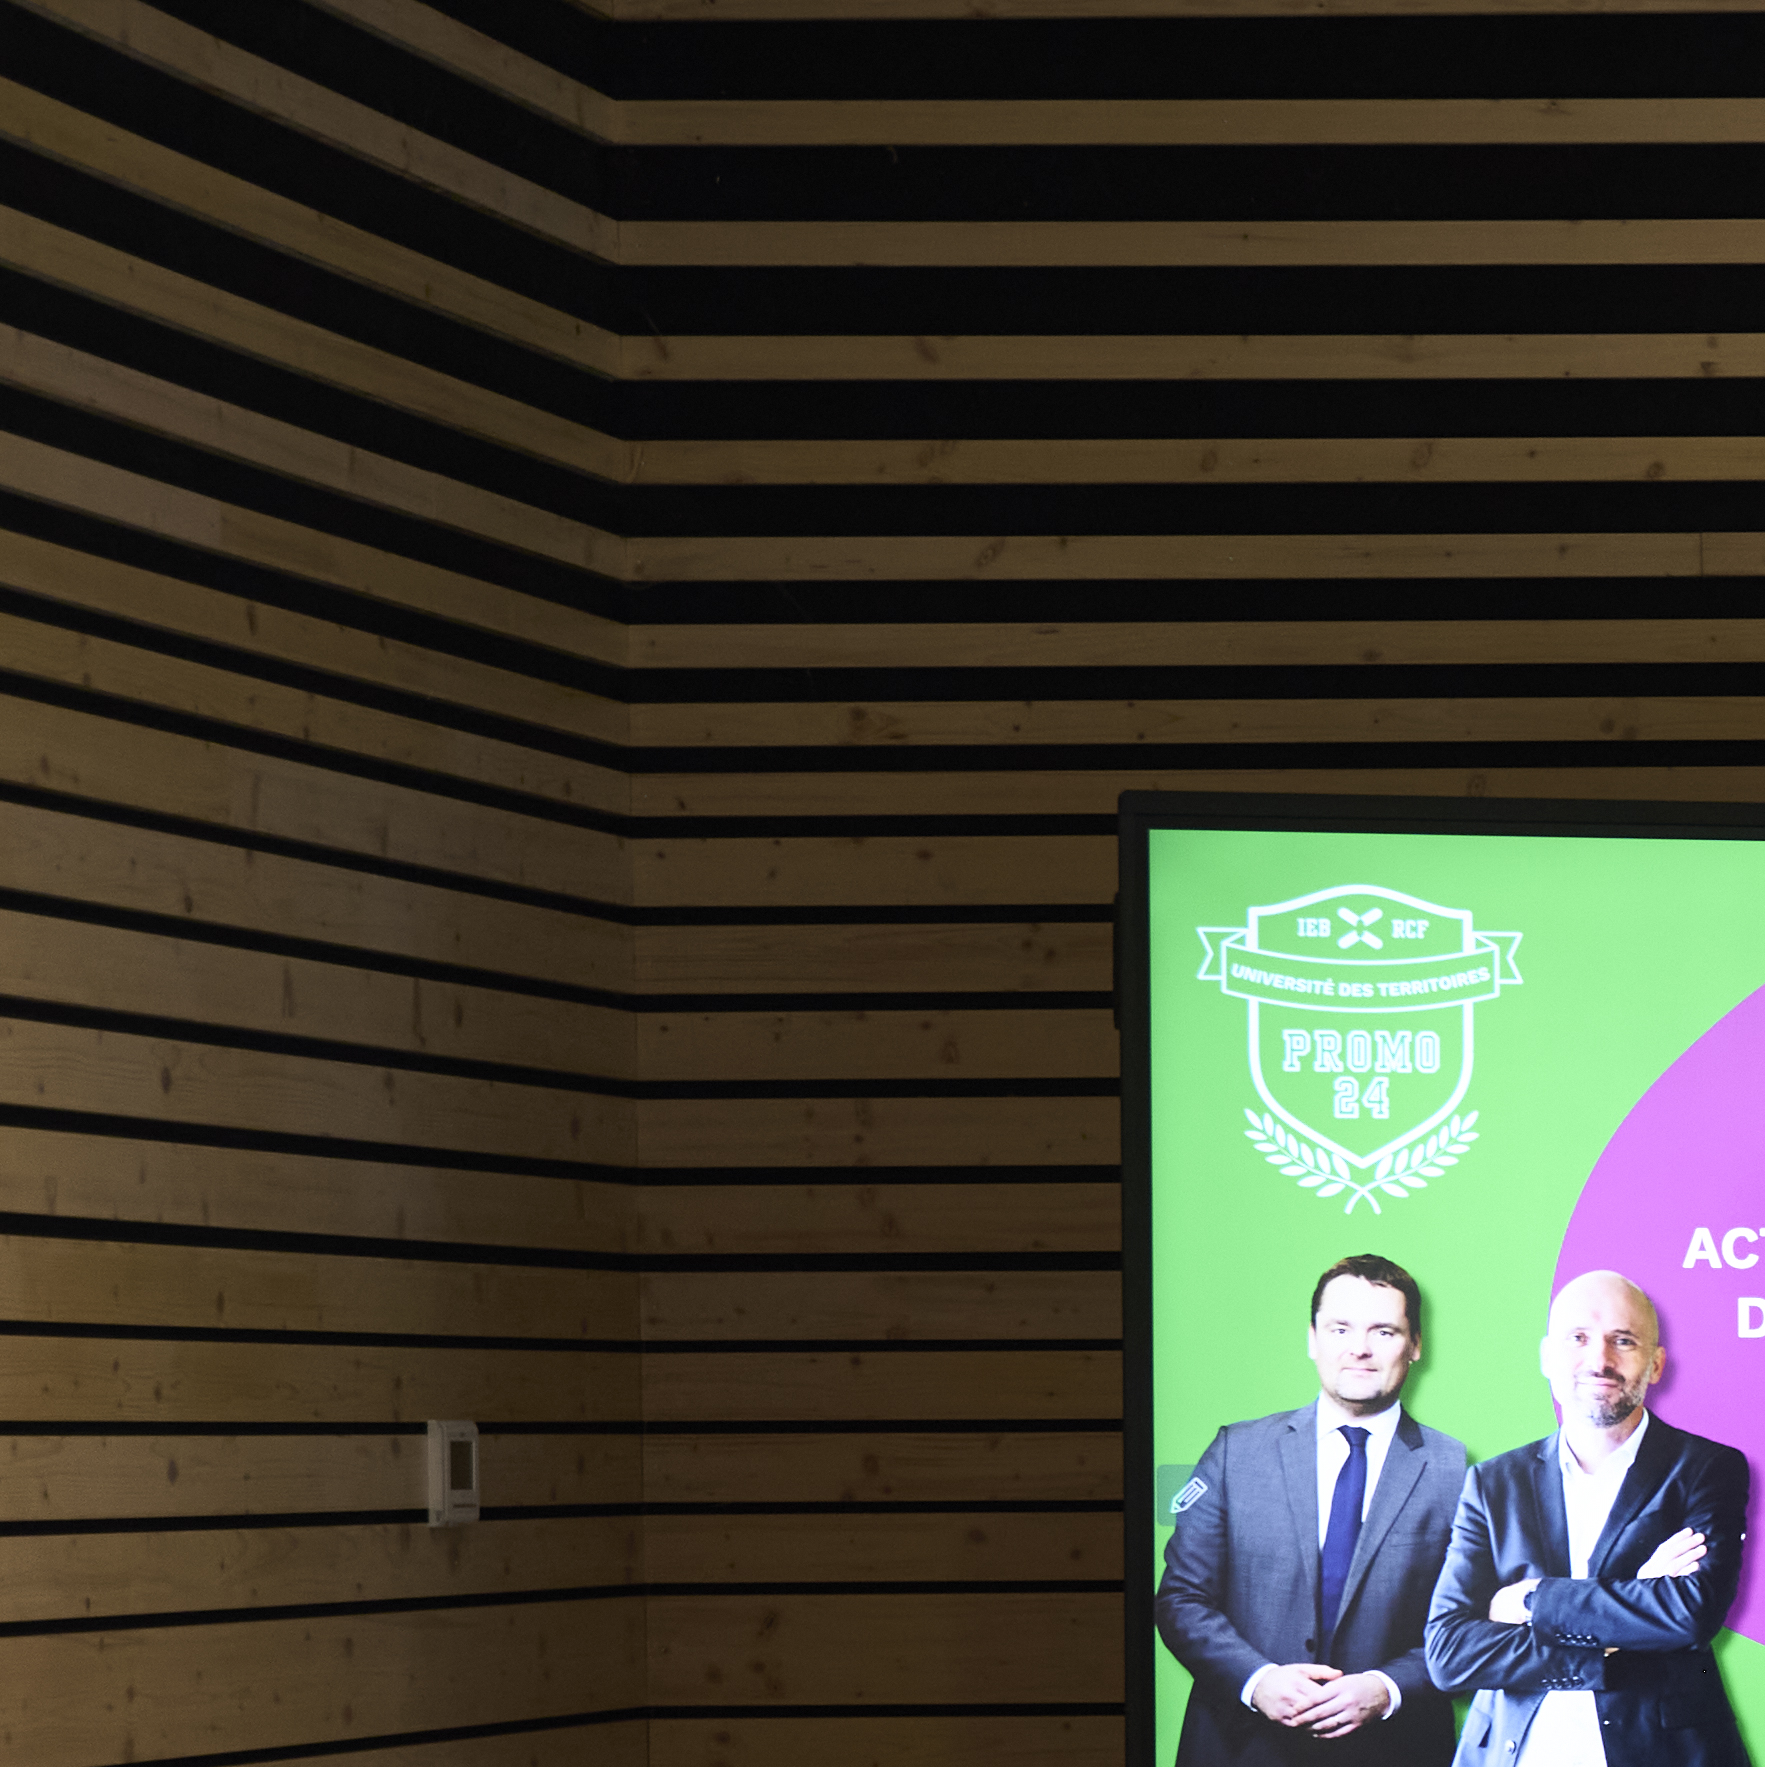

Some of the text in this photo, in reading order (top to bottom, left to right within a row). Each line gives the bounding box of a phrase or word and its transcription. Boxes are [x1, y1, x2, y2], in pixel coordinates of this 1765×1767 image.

[1296, 917, 1430, 939] IEB RCF
[1230, 962, 1492, 998] UNIVERSITÉ DES TERRITOIRES
[1281, 1028, 1442, 1074] PROMO
[1332, 1075, 1390, 1120] 24
